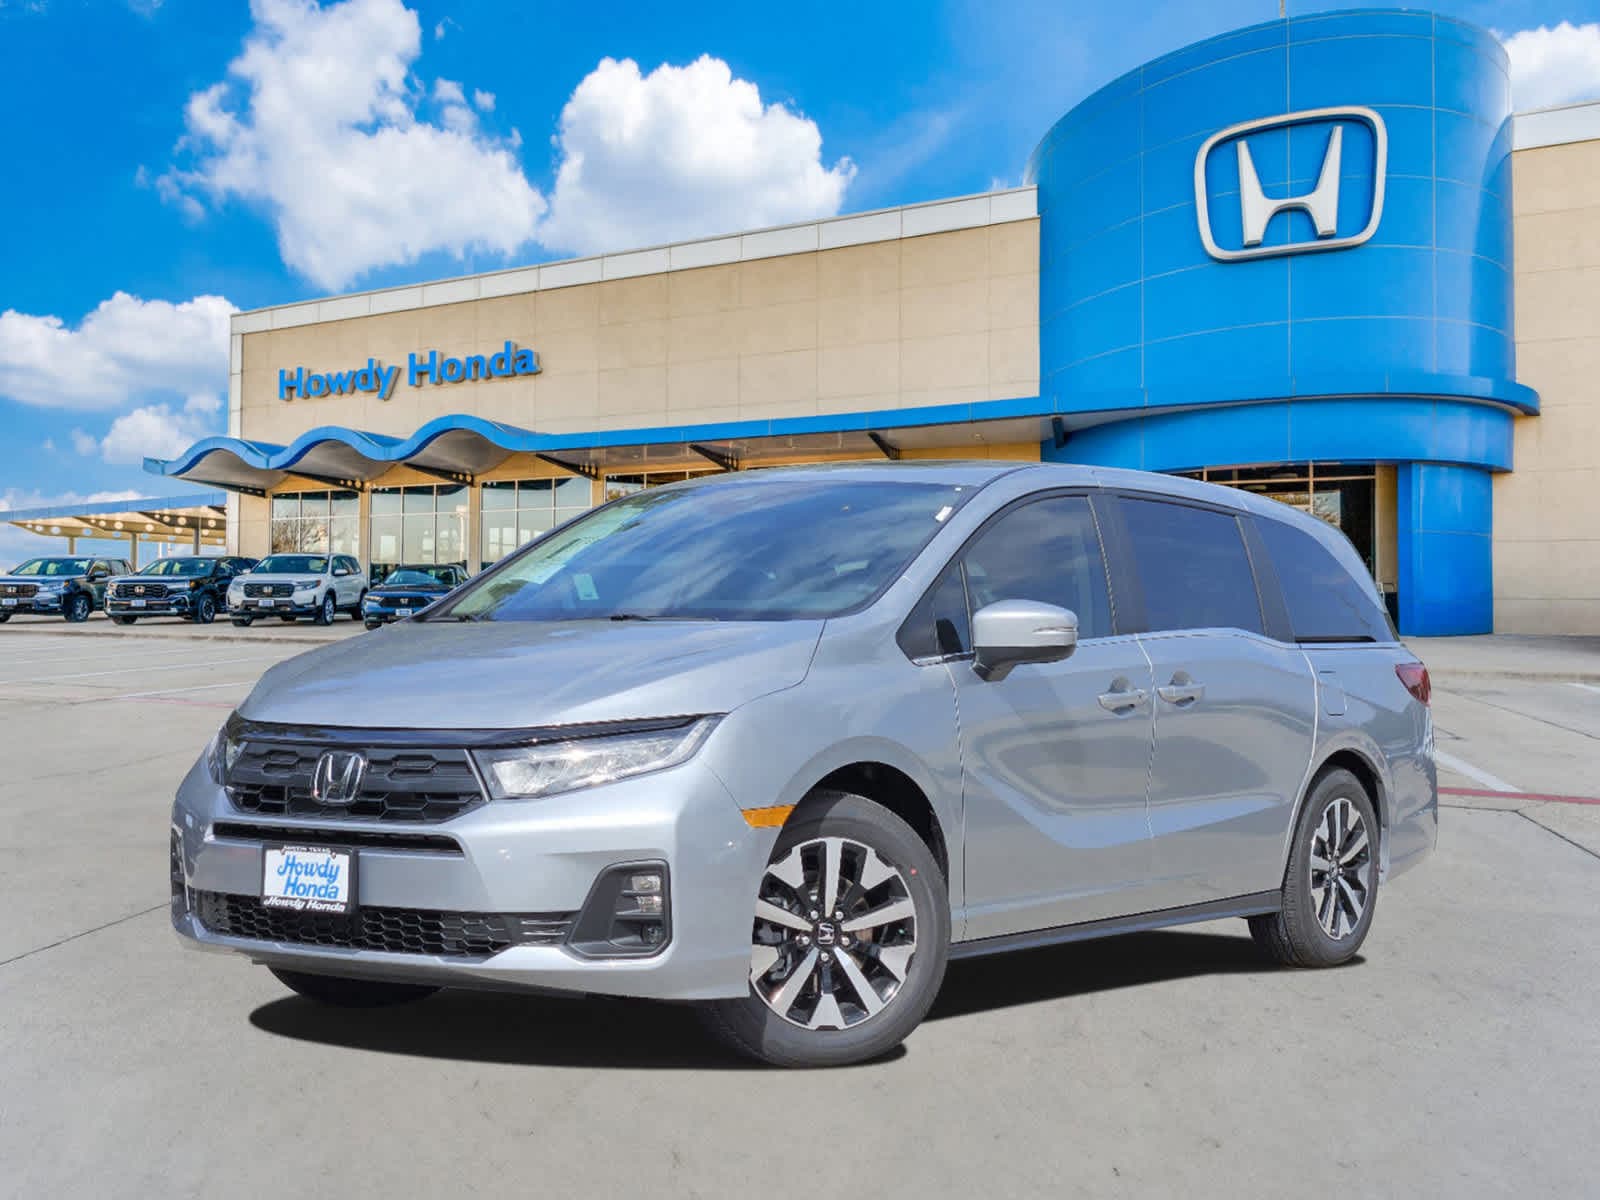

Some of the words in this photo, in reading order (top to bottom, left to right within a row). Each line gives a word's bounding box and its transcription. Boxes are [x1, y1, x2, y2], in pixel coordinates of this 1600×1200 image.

[278, 358, 399, 400] Howdy
[408, 340, 541, 386] Honda
[277, 855, 340, 883] Howdy
[283, 876, 339, 899] Honda
[263, 897, 305, 910] Howdy
[306, 900, 346, 912] Honda
